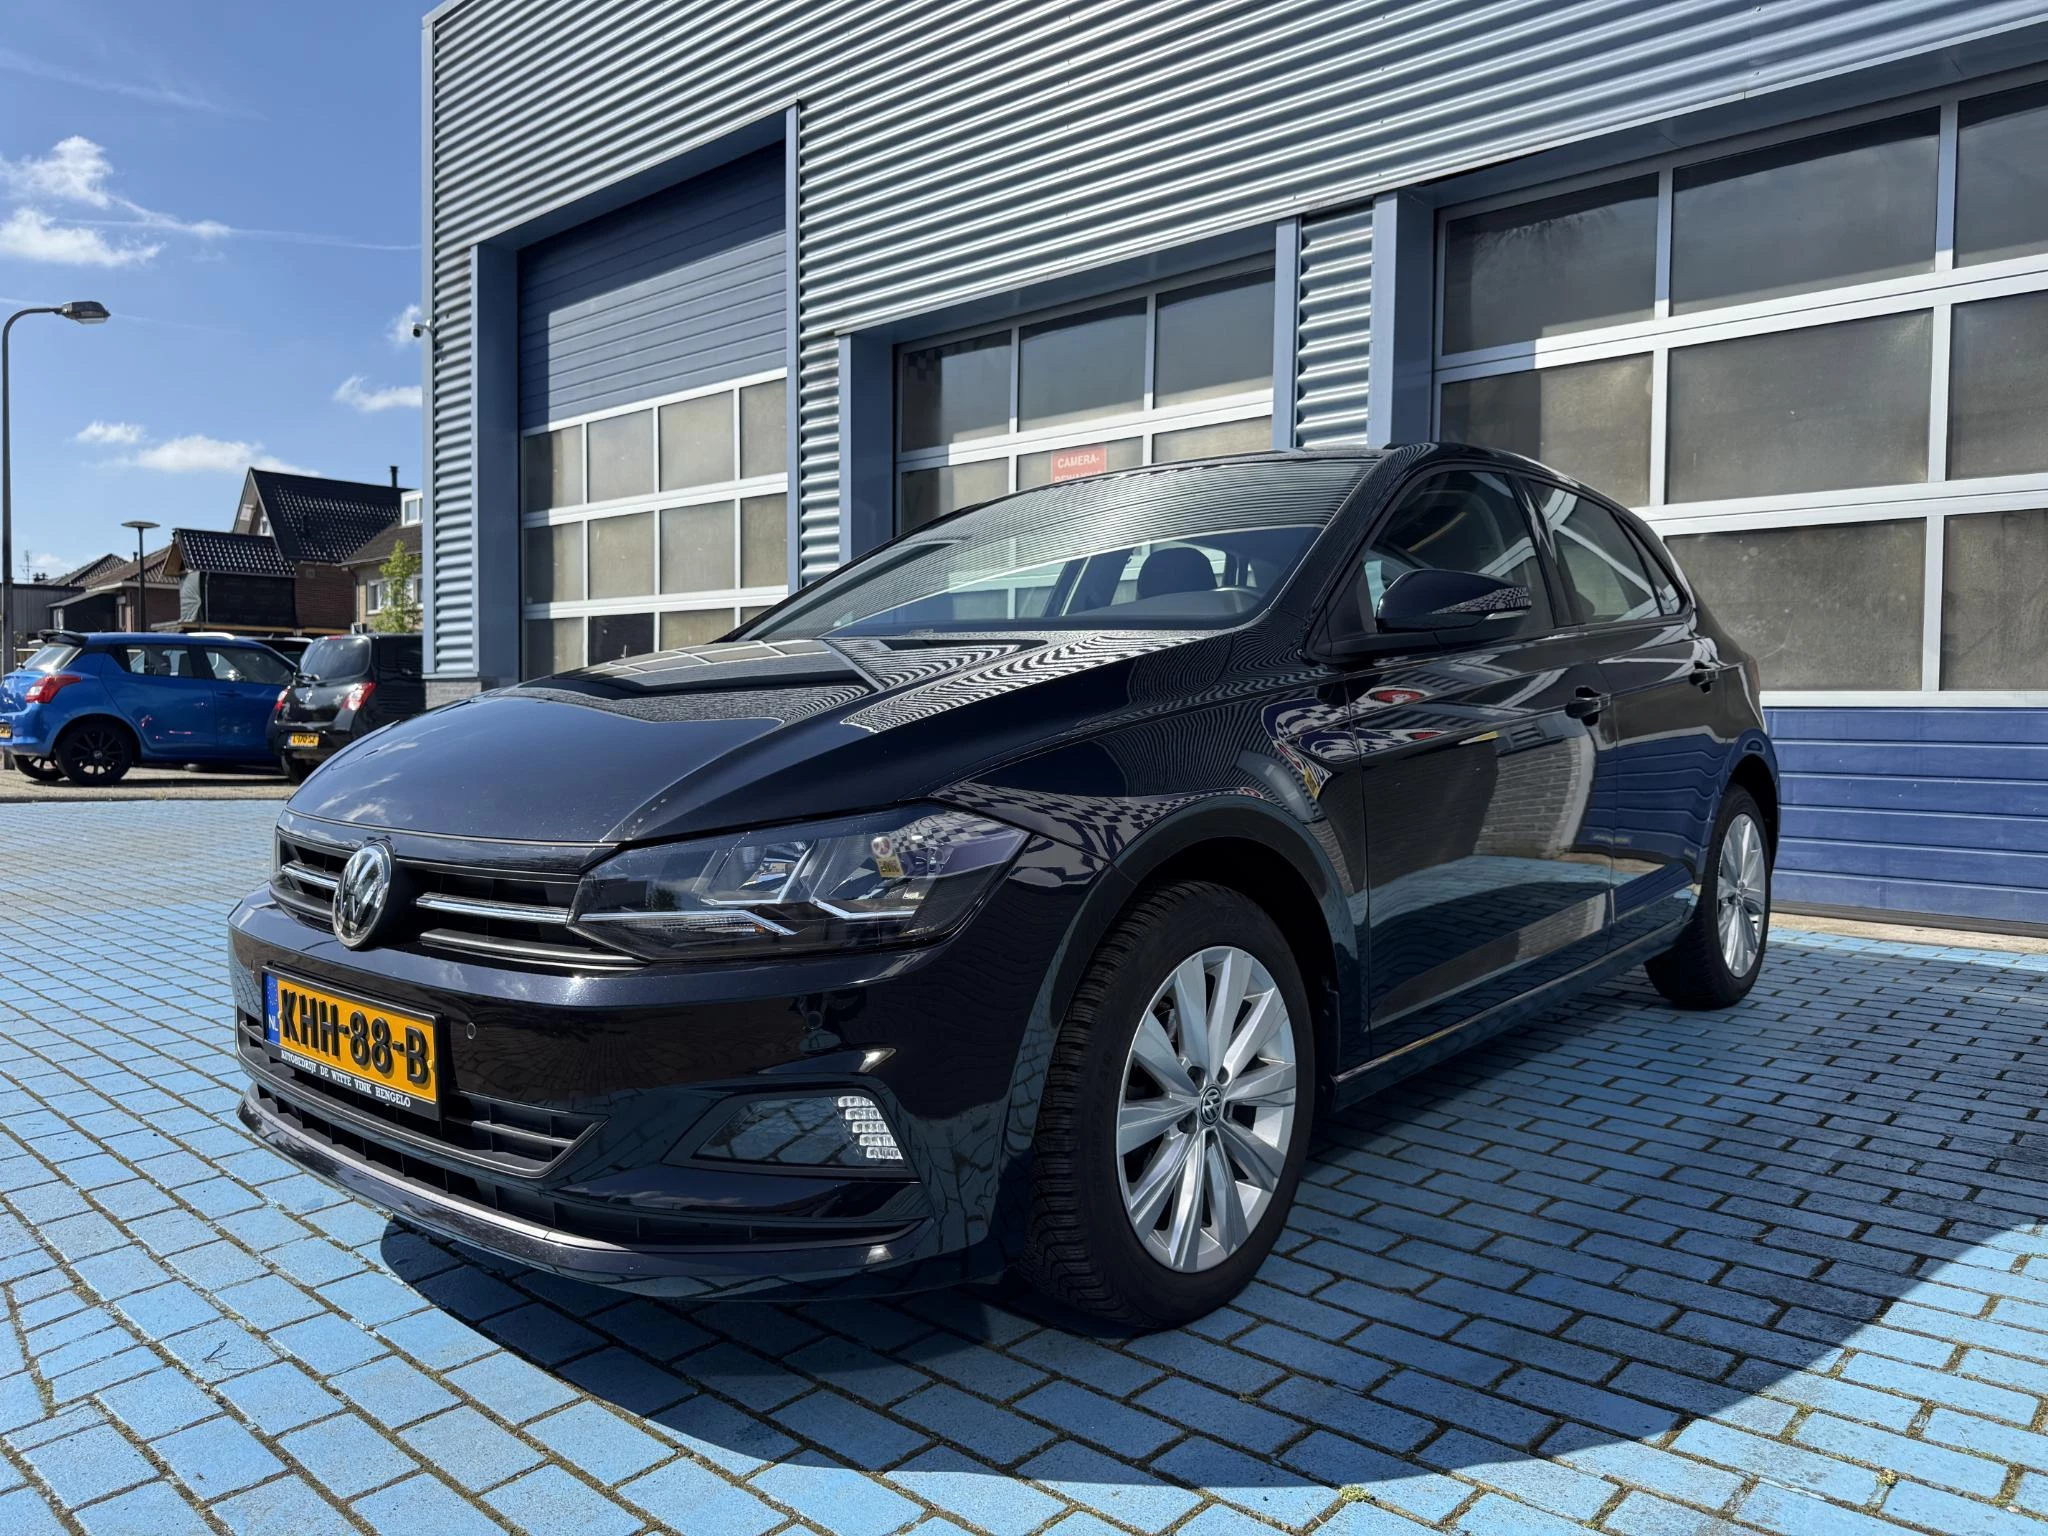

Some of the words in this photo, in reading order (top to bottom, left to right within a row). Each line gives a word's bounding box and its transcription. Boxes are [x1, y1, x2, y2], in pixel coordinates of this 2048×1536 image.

[1057, 453, 1100, 468] CAMERA-
[268, 1013, 279, 1032] NL
[280, 988, 429, 1085] KHH-88-B
[319, 1065, 329, 1077] DE
[331, 1070, 352, 1086] WITTE
[353, 1078, 372, 1094] VINK
[374, 1086, 411, 1108] HENGELO
